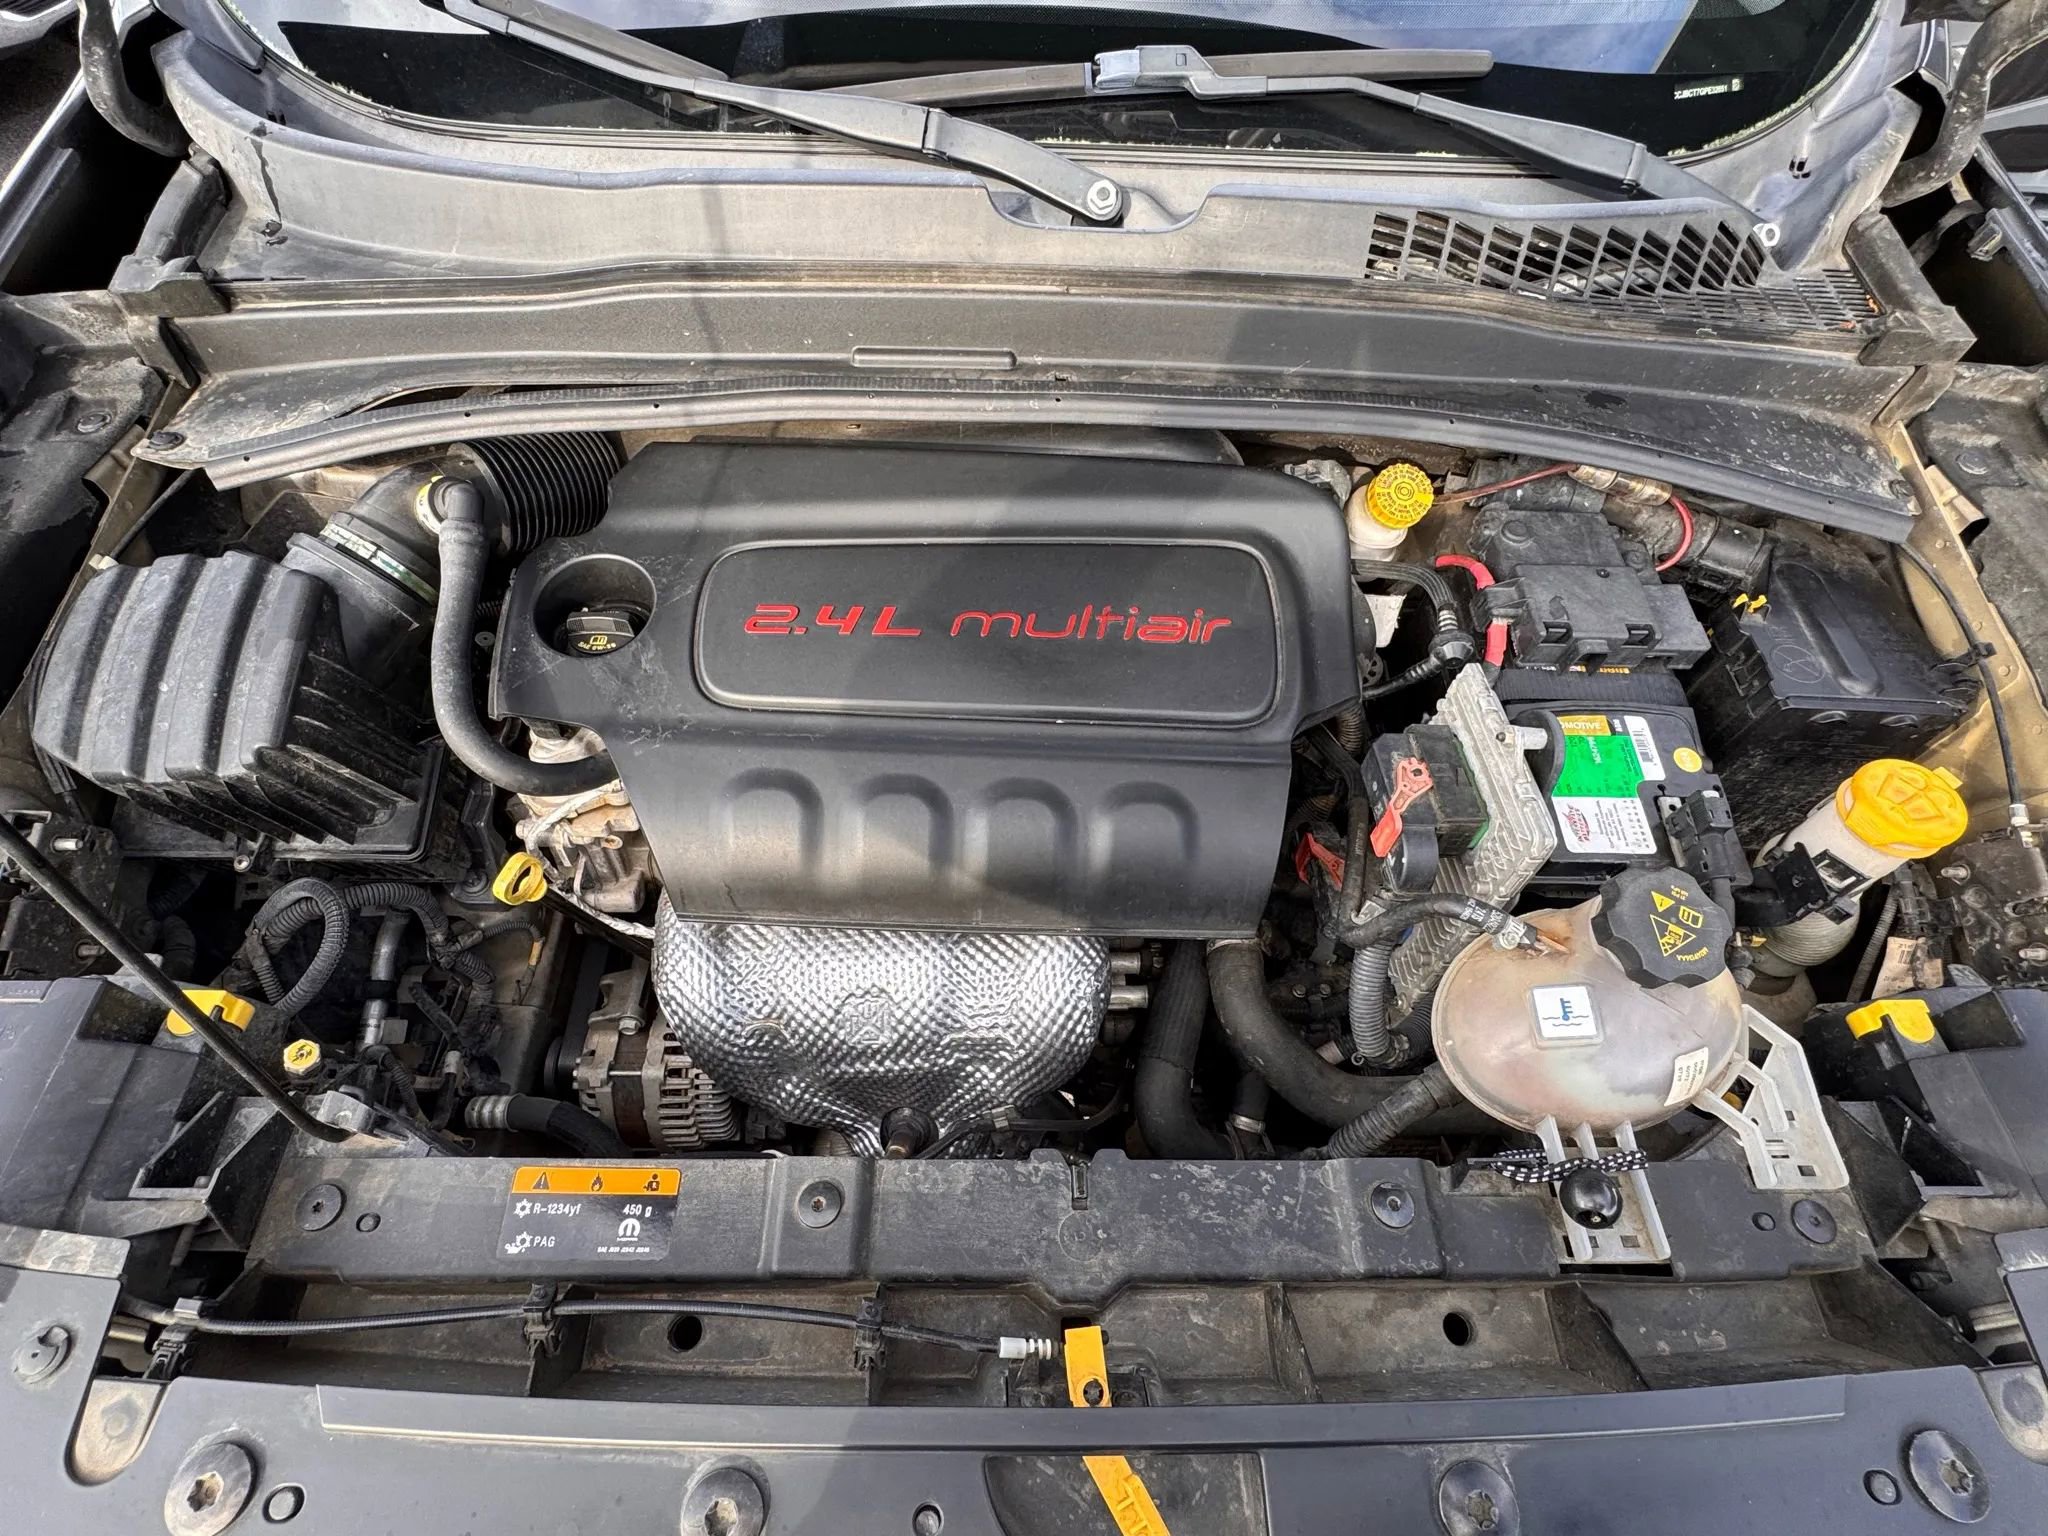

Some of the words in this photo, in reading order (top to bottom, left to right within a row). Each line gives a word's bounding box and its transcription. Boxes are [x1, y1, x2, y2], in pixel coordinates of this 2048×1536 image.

[950, 602, 1233, 645] multiair
[578, 641, 591, 650] SAE
[533, 1203, 581, 1218] R-1234yf
[622, 1203, 642, 1215] 450
[644, 1205, 653, 1218] g
[533, 1235, 556, 1247] PAG
